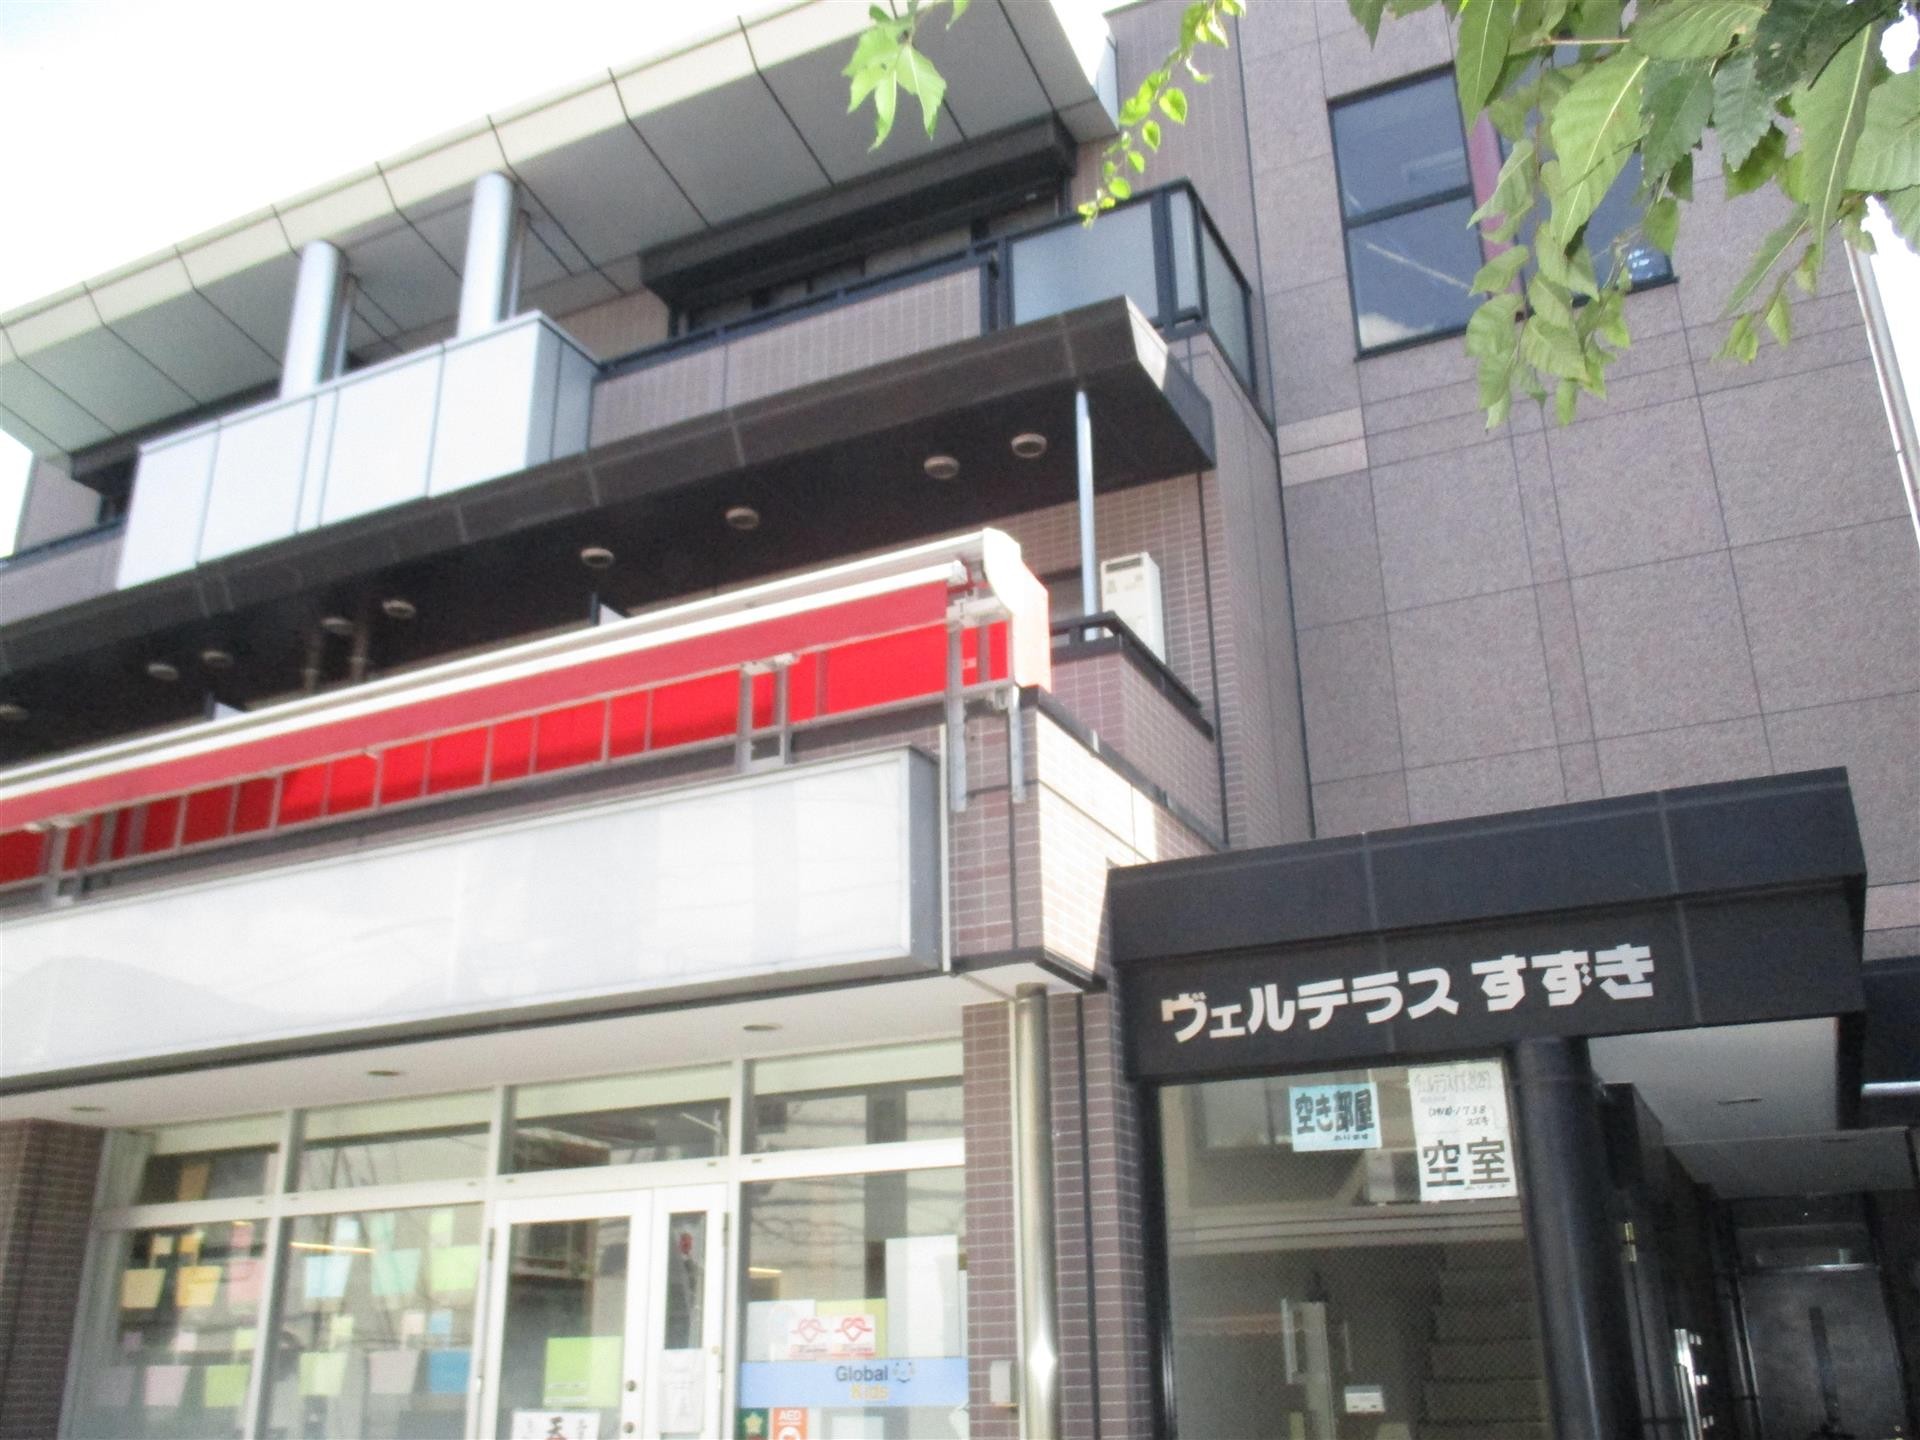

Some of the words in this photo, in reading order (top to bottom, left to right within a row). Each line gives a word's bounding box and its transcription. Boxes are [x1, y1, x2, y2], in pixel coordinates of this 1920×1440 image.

[1161, 968, 1459, 1043] ヴェルテラス
[1471, 944, 1655, 1012] すずき
[1295, 1089, 1375, 1135] 空き部屋
[1423, 1136, 1511, 1188] 空室
[835, 1365, 889, 1382] Global
[778, 1410, 802, 1421] AED
